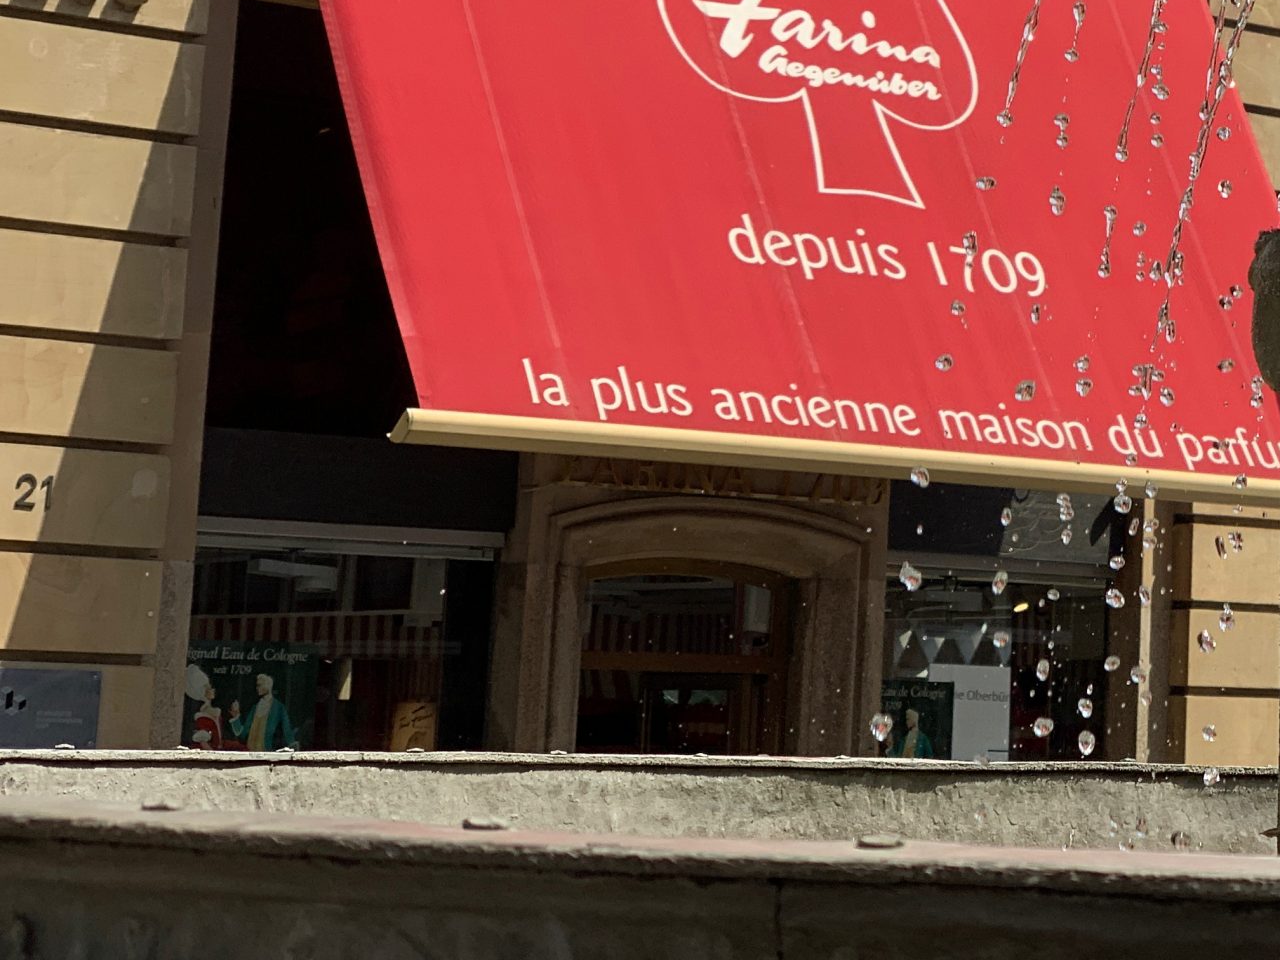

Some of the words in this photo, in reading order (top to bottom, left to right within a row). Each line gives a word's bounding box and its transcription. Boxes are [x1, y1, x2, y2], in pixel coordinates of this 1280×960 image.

[758, 44, 942, 101] Gegenüber
[728, 215, 906, 280] depuis
[926, 240, 1046, 297] 1709
[522, 358, 569, 407] la
[591, 365, 693, 420] plus
[710, 384, 921, 437] ancienne
[938, 404, 1093, 452] maison
[1108, 414, 1163, 459] du
[13, 473, 54, 511] 21
[188, 645, 219, 662] iginal
[221, 646, 244, 661] Eau
[247, 648, 260, 661] de
[263, 648, 309, 665] Cologne
[230, 664, 252, 675] 1709
